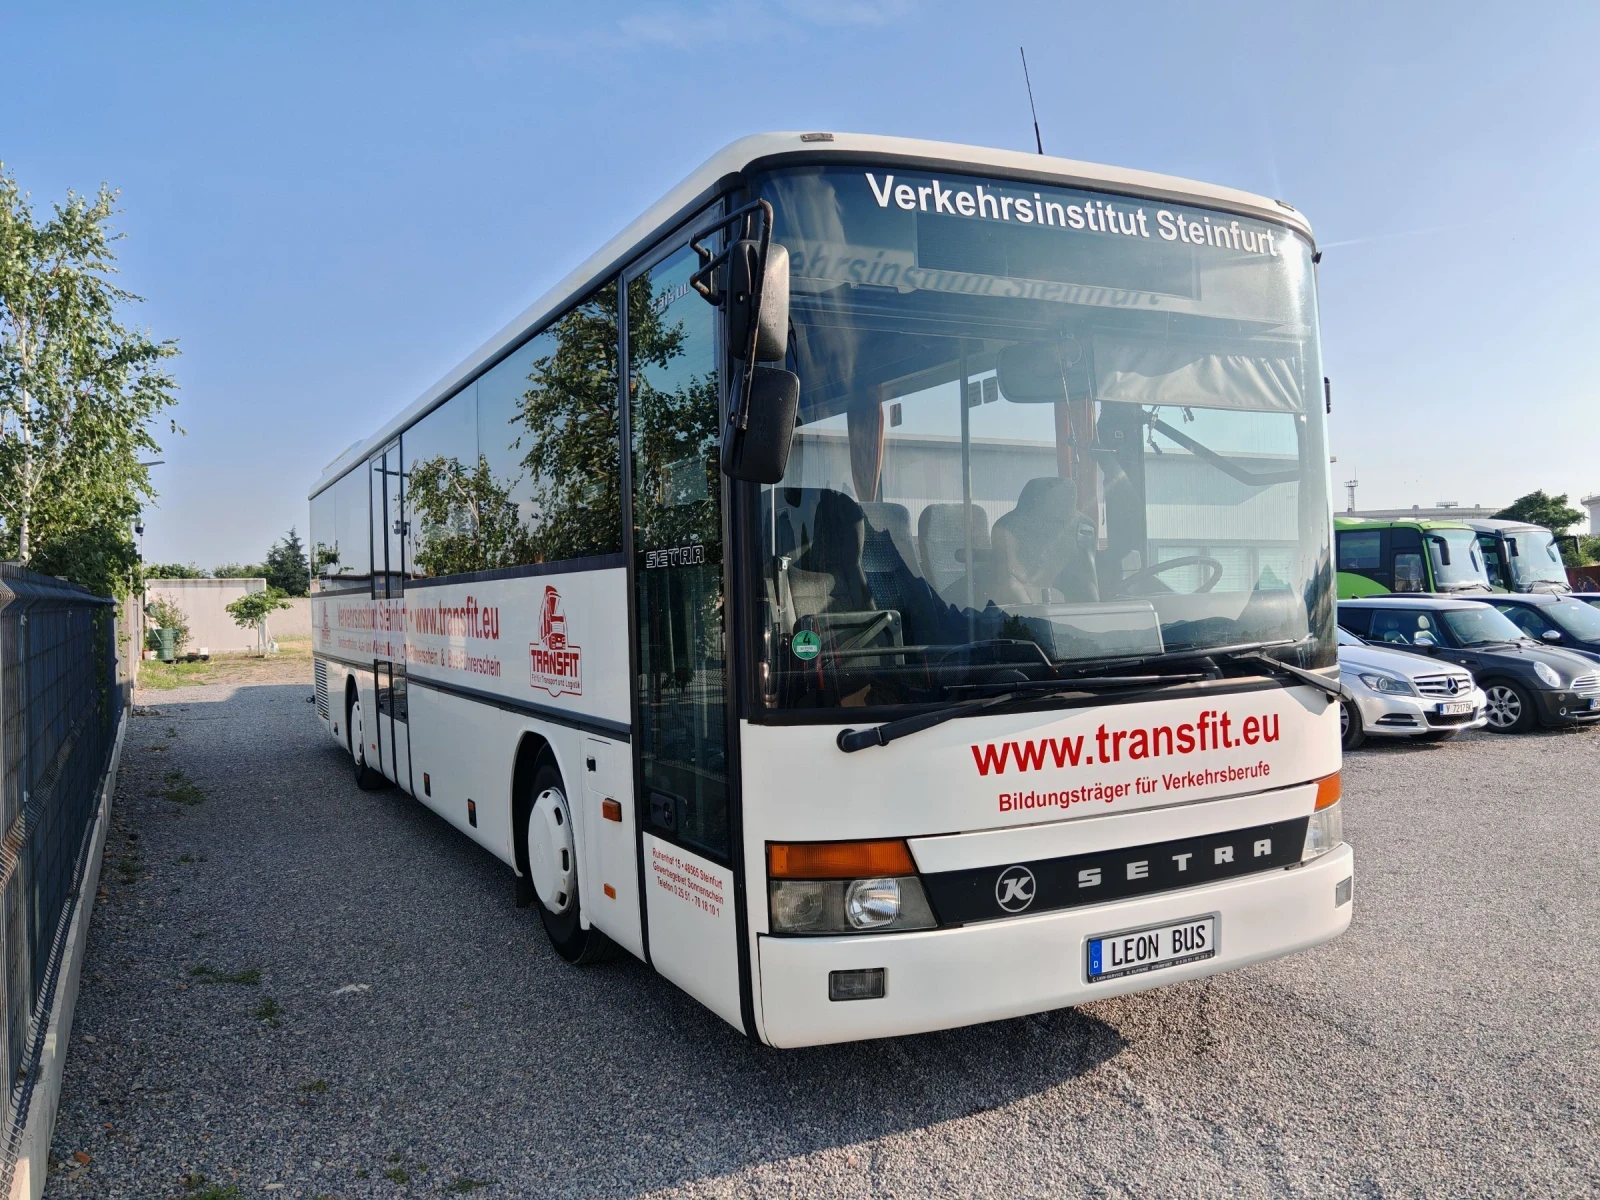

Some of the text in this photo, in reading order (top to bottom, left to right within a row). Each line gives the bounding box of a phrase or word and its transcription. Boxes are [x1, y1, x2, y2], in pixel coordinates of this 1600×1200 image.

[865, 172, 1278, 257] Verkehrsinstitut Steinfurt
[646, 545, 704, 568] SETRA
[415, 596, 499, 640] www.transfit.eu
[803, 632, 811, 645] 4
[531, 650, 579, 678] TRANSFIT
[971, 710, 1280, 776] www.transfit.eu
[999, 760, 1271, 812] Bildungsträger für Verkehrsberufe
[652, 860, 724, 905] Gewerbegebiet Sonnenschein
[657, 875, 673, 892] Telefon
[675, 858, 681, 869] 15
[700, 869, 723, 890] Steinfurt
[1078, 839, 1272, 888] SETRA
[1093, 960, 1099, 969] D
[1112, 924, 1205, 967] LEON BUS
